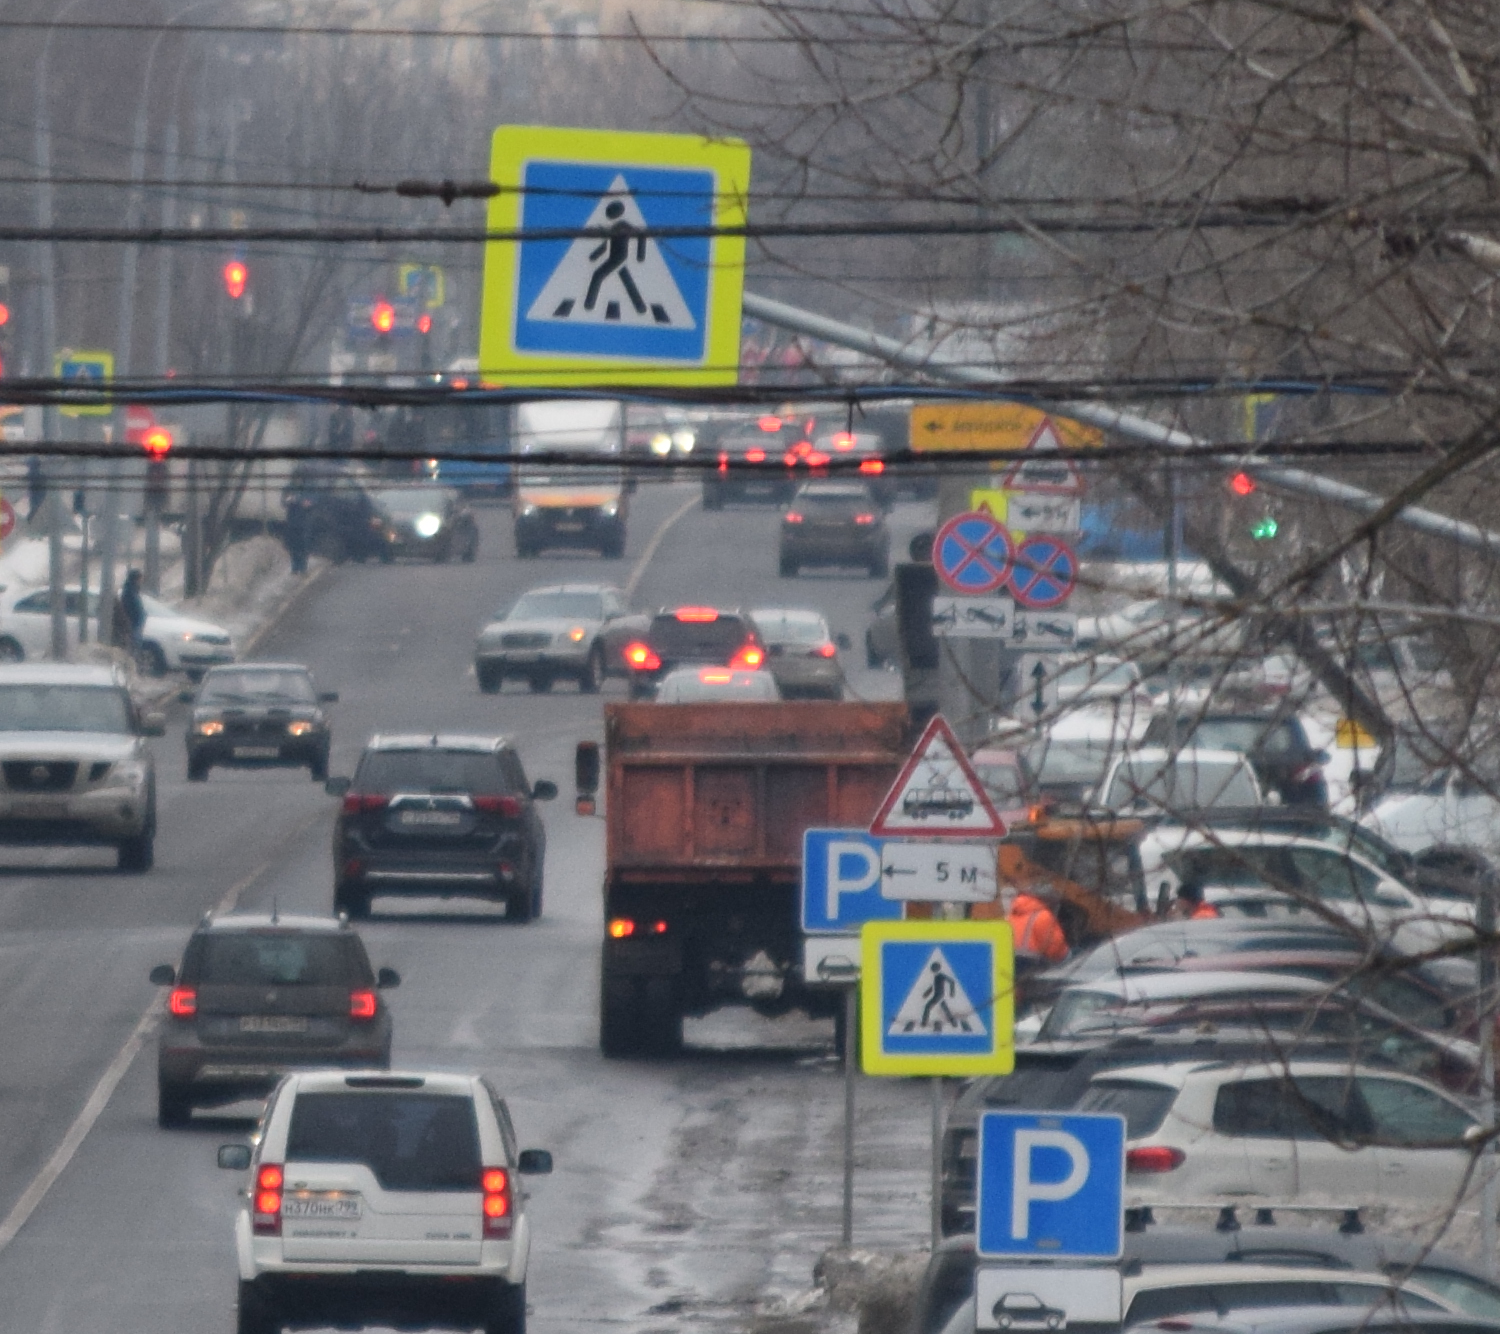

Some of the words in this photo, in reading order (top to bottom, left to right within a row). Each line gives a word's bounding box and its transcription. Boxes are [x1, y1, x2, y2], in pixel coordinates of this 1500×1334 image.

[826, 841, 882, 920] P
[936, 861, 950, 883] 5
[1011, 1128, 1091, 1241] P
